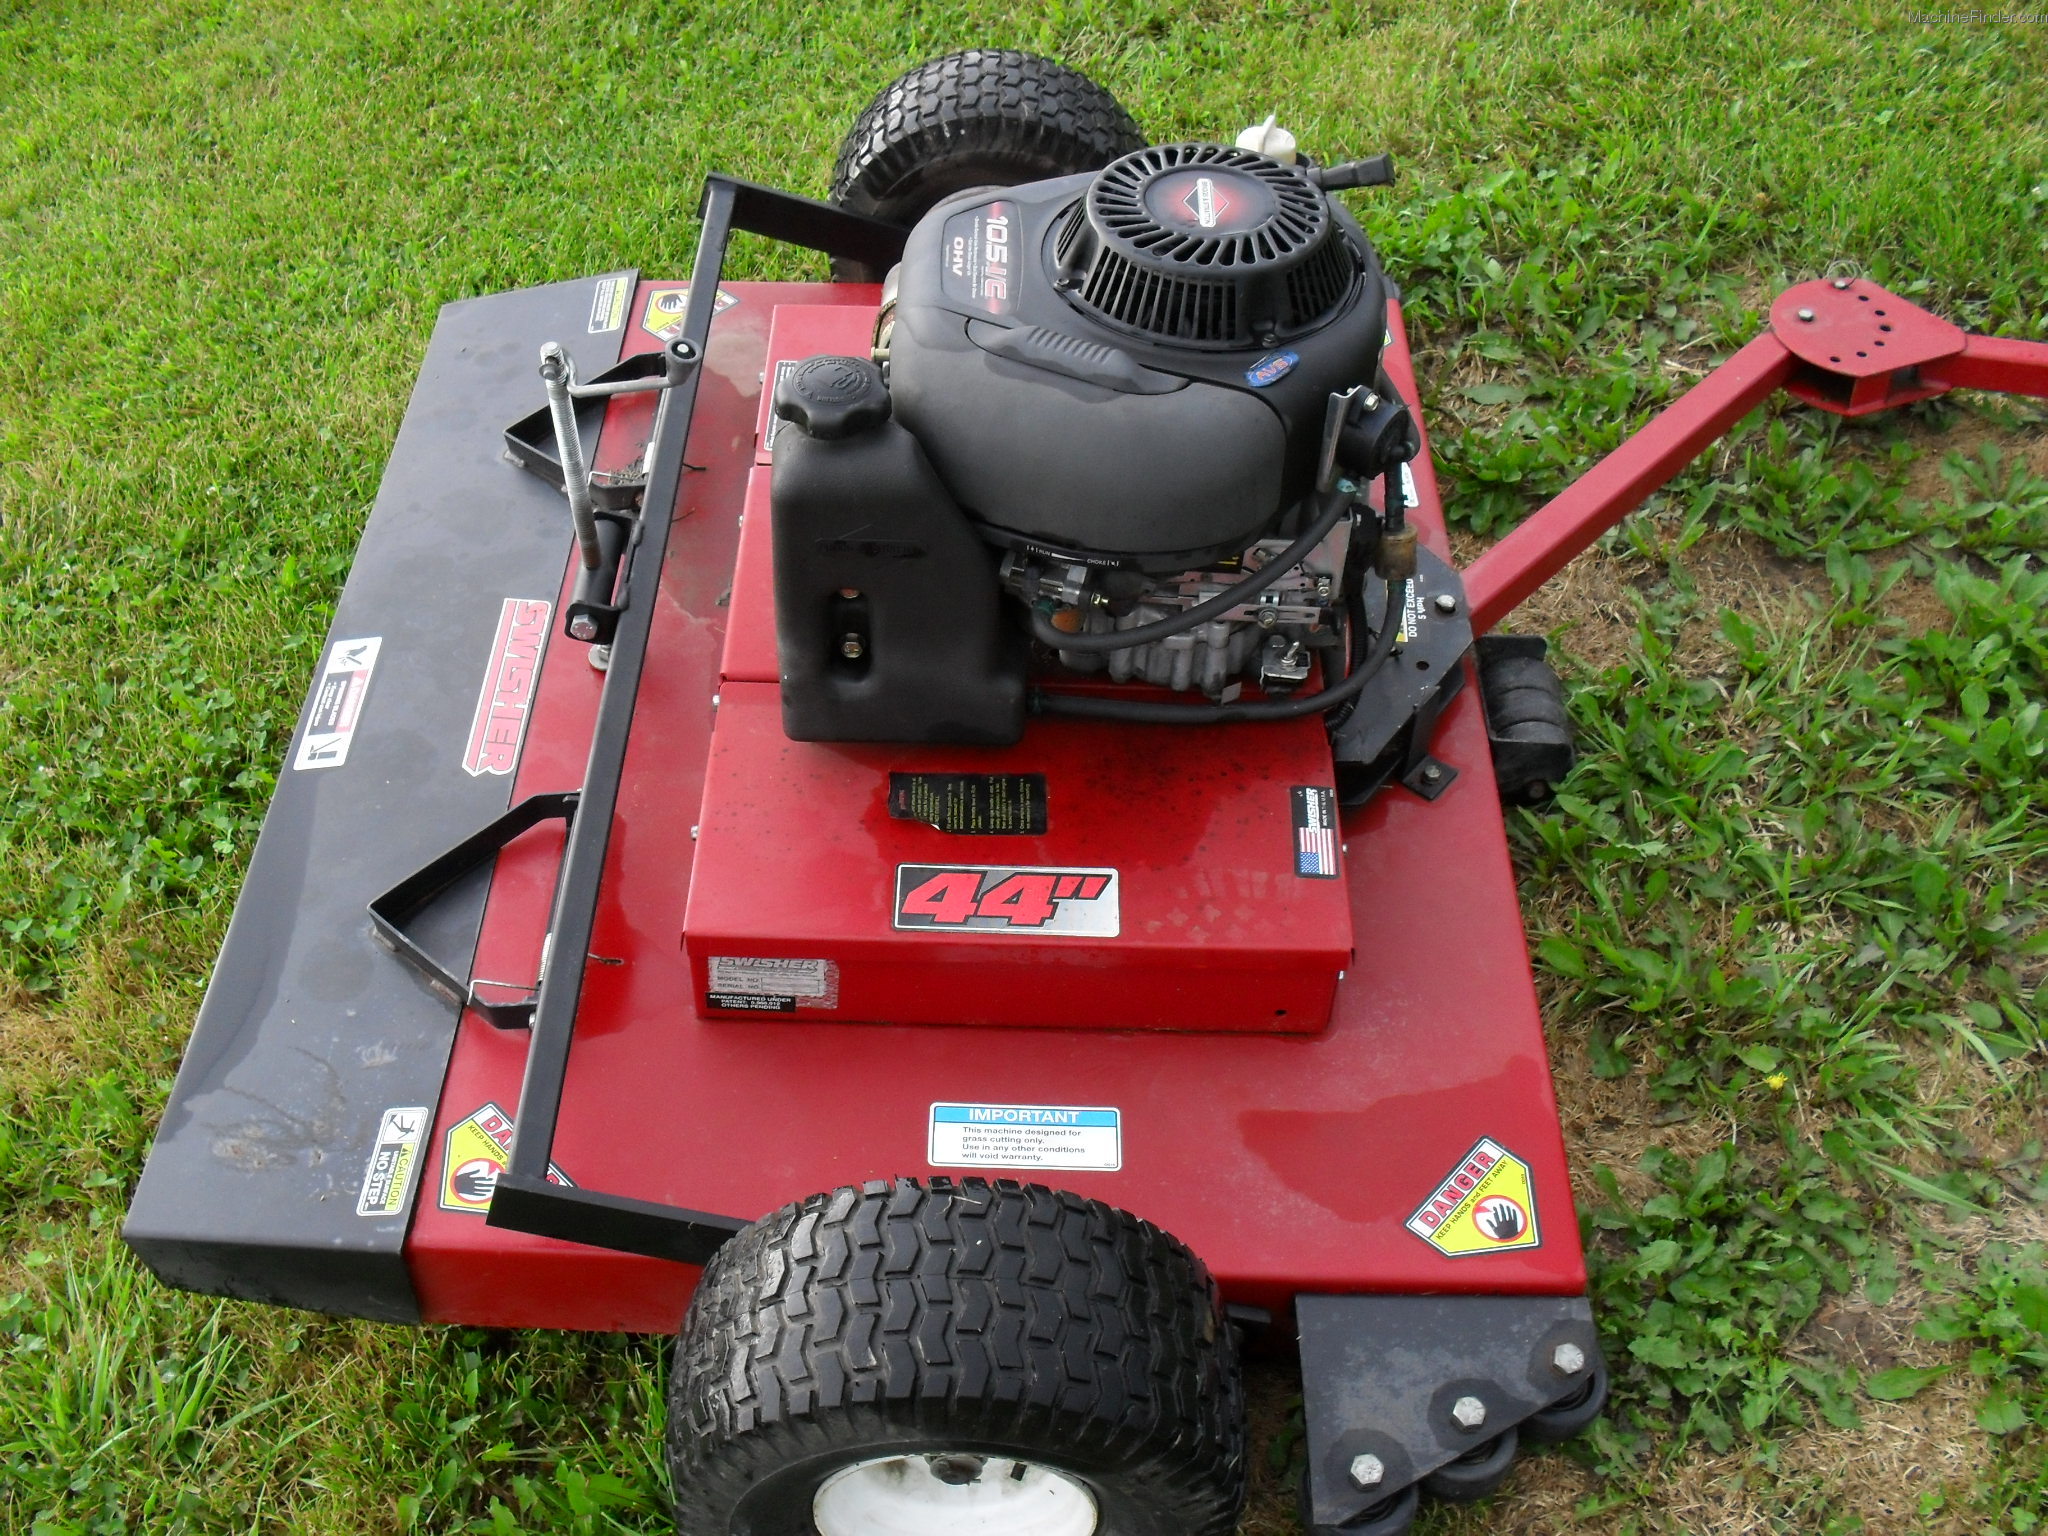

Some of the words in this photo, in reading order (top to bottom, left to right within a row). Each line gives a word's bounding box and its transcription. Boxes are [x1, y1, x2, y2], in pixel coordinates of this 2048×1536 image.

[952, 236, 964, 277] OHV
[1407, 609, 1416, 625] NOT
[1408, 626, 1417, 637] DO
[477, 600, 551, 773] SWISHER
[1305, 787, 1321, 834] SWISHER
[718, 957, 819, 973] SWISHER
[968, 1108, 1080, 1124] IMPORTANT
[468, 1124, 485, 1141] KEEP
[482, 1138, 504, 1161] HANDS
[962, 1127, 982, 1135] This
[984, 1127, 1022, 1136] machine
[1025, 1128, 1066, 1138] designed
[1068, 1129, 1082, 1137] for
[962, 1136, 988, 1144] grass
[990, 1137, 1021, 1145] cutting
[1024, 1138, 1045, 1146] only.
[961, 1152, 977, 1160] will
[993, 1146, 1009, 1154] any
[1011, 1145, 1036, 1153] other
[1038, 1146, 1086, 1154] conditions
[376, 1151, 391, 1171] NO
[367, 1172, 385, 1205] STEP
[388, 1158, 409, 1206] CAUTION
[1418, 1151, 1497, 1230] DANGER
[1436, 1223, 1452, 1240] KEEP
[1449, 1201, 1472, 1225] HANDS
[1470, 1191, 1482, 1204] and
[1478, 1177, 1494, 1193] FEET
[1491, 1159, 1509, 1179] AWAY
